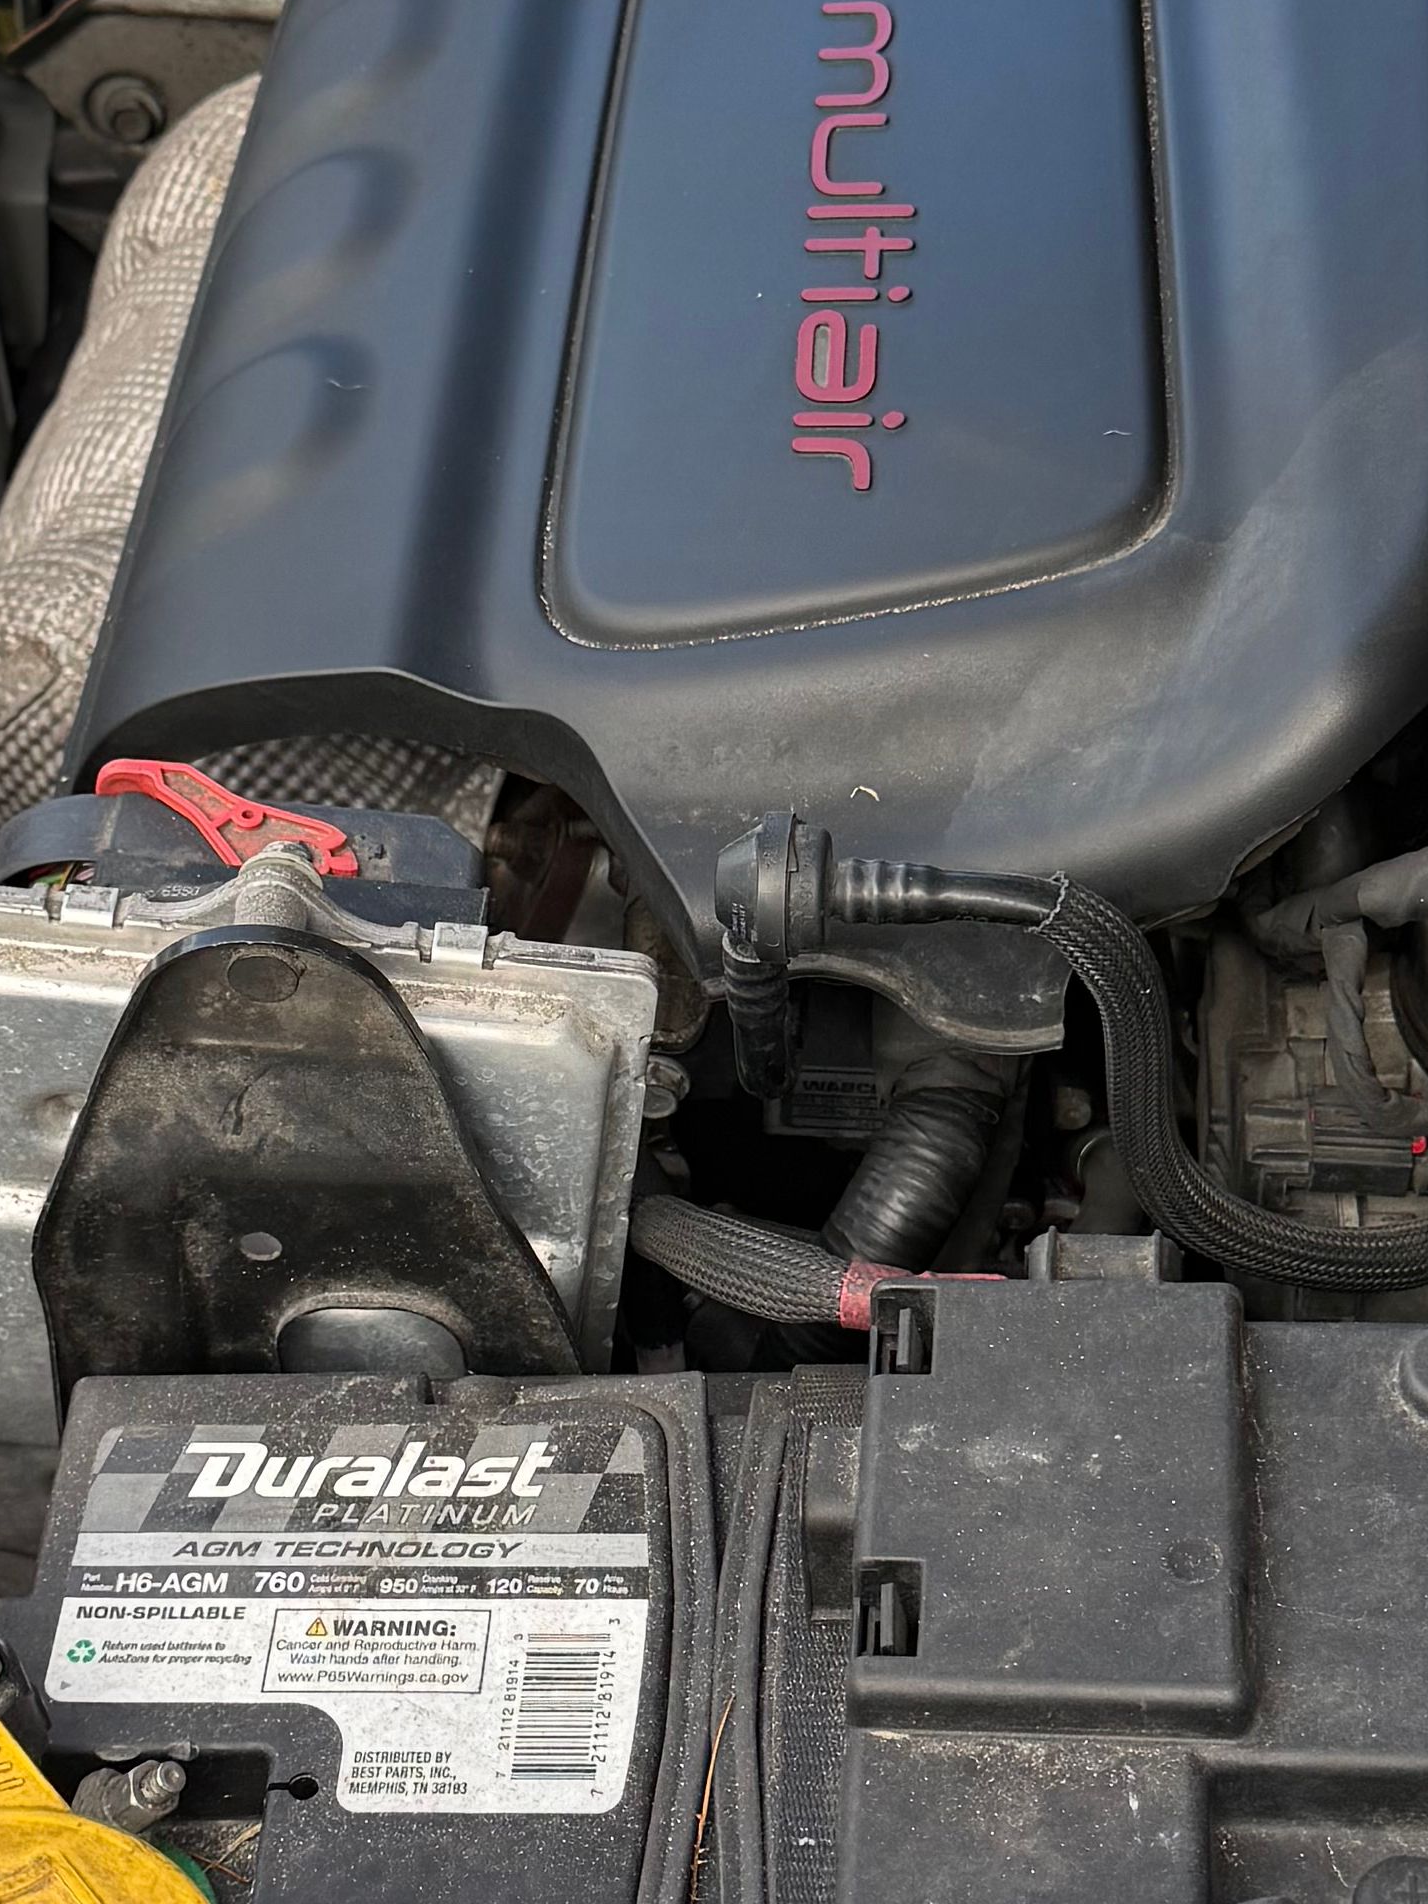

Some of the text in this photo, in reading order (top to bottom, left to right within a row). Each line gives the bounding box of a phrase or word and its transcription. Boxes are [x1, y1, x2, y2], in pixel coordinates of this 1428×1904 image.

[791, 0, 917, 491] multiair
[184, 1441, 556, 1498] Duralast
[311, 1503, 538, 1526] PLATINUM
[172, 1540, 526, 1560] AGM TECHNOLOGY
[115, 1571, 305, 1594] H6-AGM 760
[378, 1577, 419, 1595] 950
[486, 1577, 523, 1595] 120
[573, 1577, 601, 1595] 70
[75, 1605, 247, 1621] NON-SPILLABLE
[333, 1619, 457, 1637] WARNING:
[101, 1640, 227, 1651] Return used batteries to
[275, 1638, 481, 1653] Cancer and Reproductive Harm.
[97, 1654, 253, 1666] AutoZone for proper recycling
[289, 1652, 463, 1668] Wash hands after handling.
[276, 1669, 469, 1686] www.P65Warnings.ca.gov
[503, 1659, 519, 1702] 81914
[597, 1650, 617, 1702] 81914
[497, 1707, 515, 1751] 21112
[590, 1711, 612, 1763] 21112
[354, 1751, 453, 1764] DISTRIBUTED BY
[351, 1765, 383, 1779] BEST
[384, 1765, 426, 1781] PARTS,
[348, 1781, 409, 1796] MEMPHIS,
[412, 1781, 429, 1795] TN
